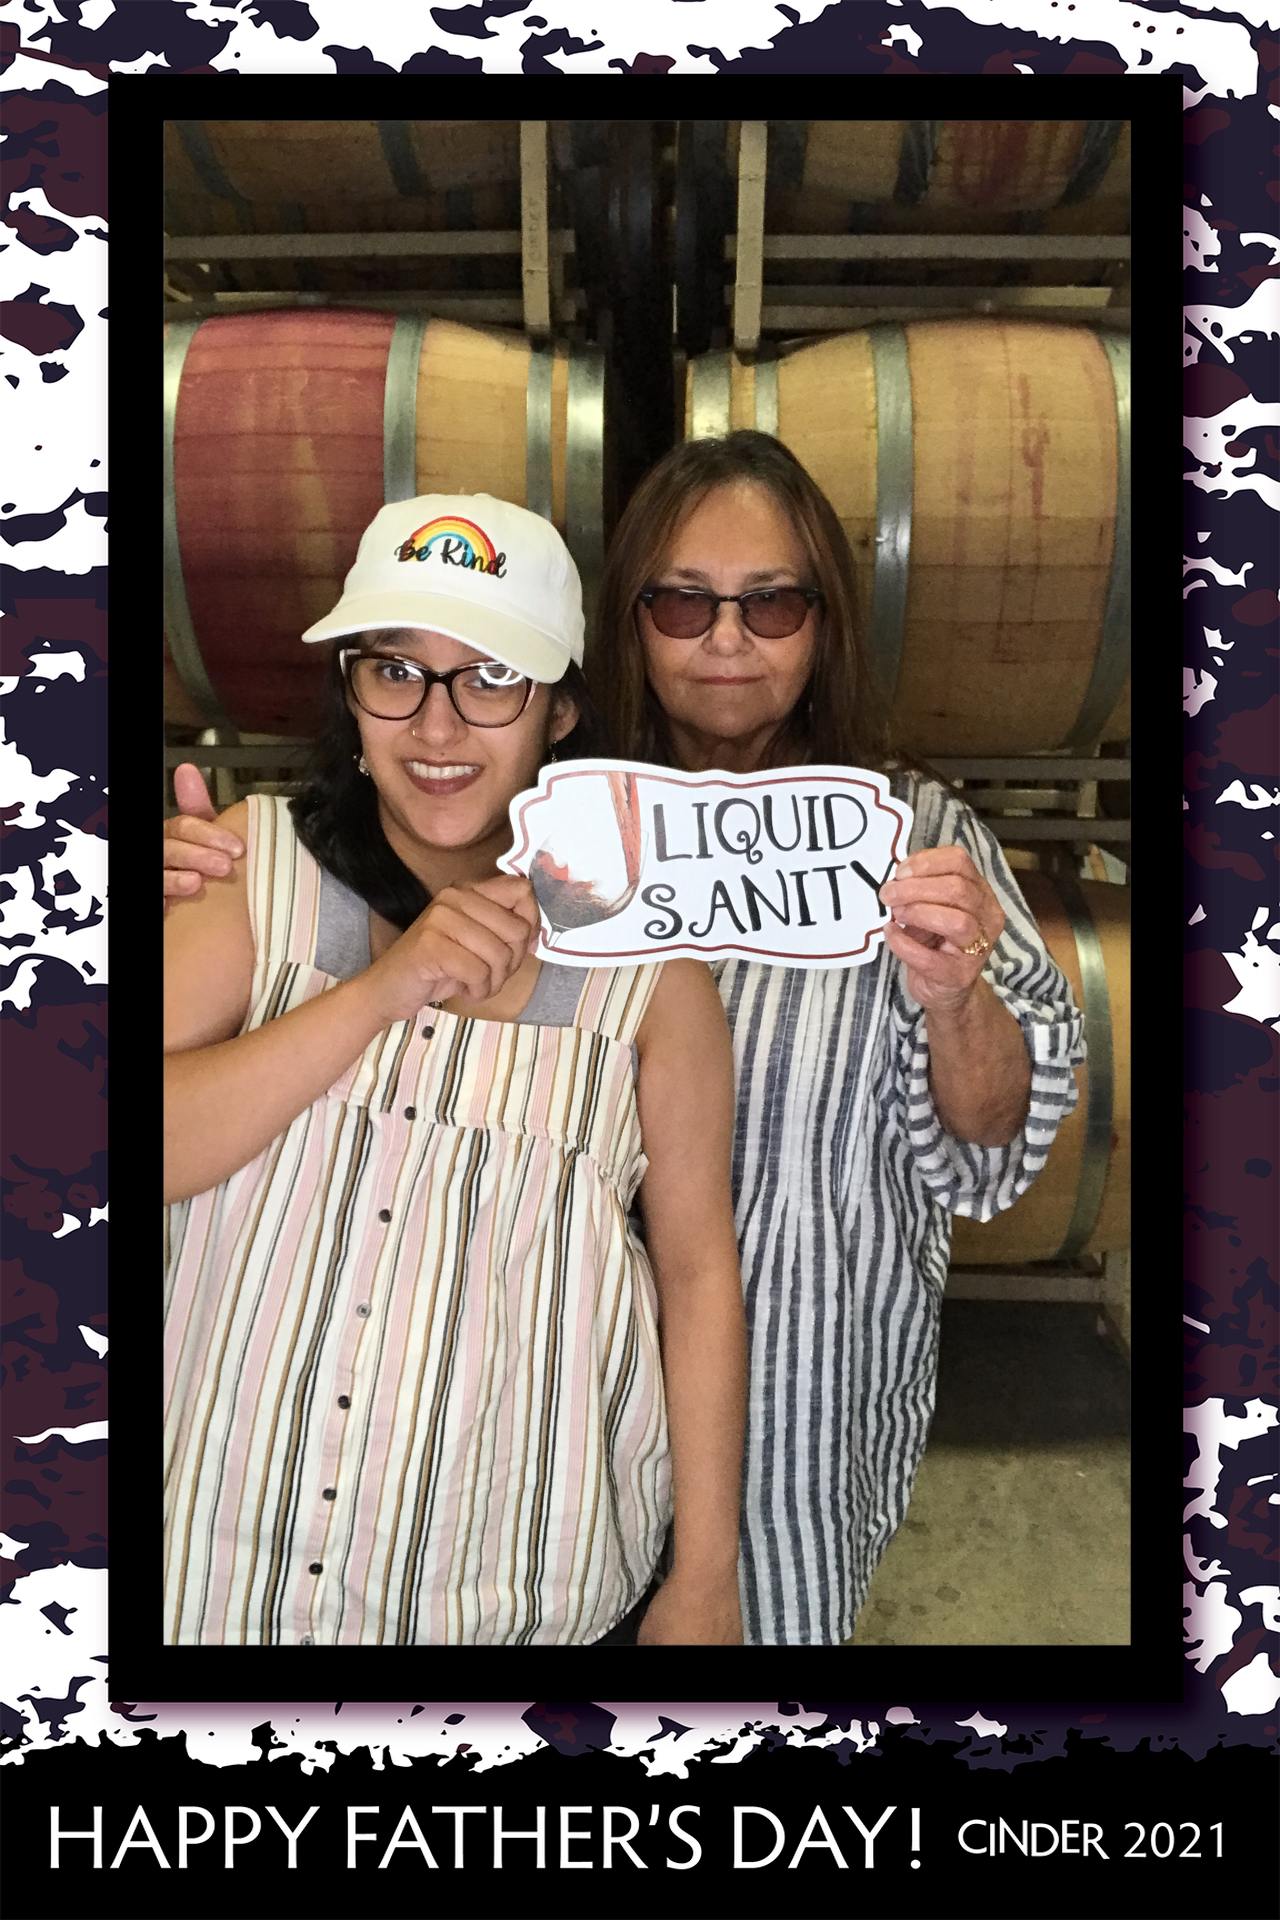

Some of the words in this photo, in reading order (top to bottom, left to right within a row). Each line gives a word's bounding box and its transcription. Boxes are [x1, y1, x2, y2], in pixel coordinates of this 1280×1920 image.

[393, 538, 432, 562] Be
[440, 538, 507, 579] Kind
[653, 793, 867, 864] LIQUID
[641, 859, 896, 940] SANITY
